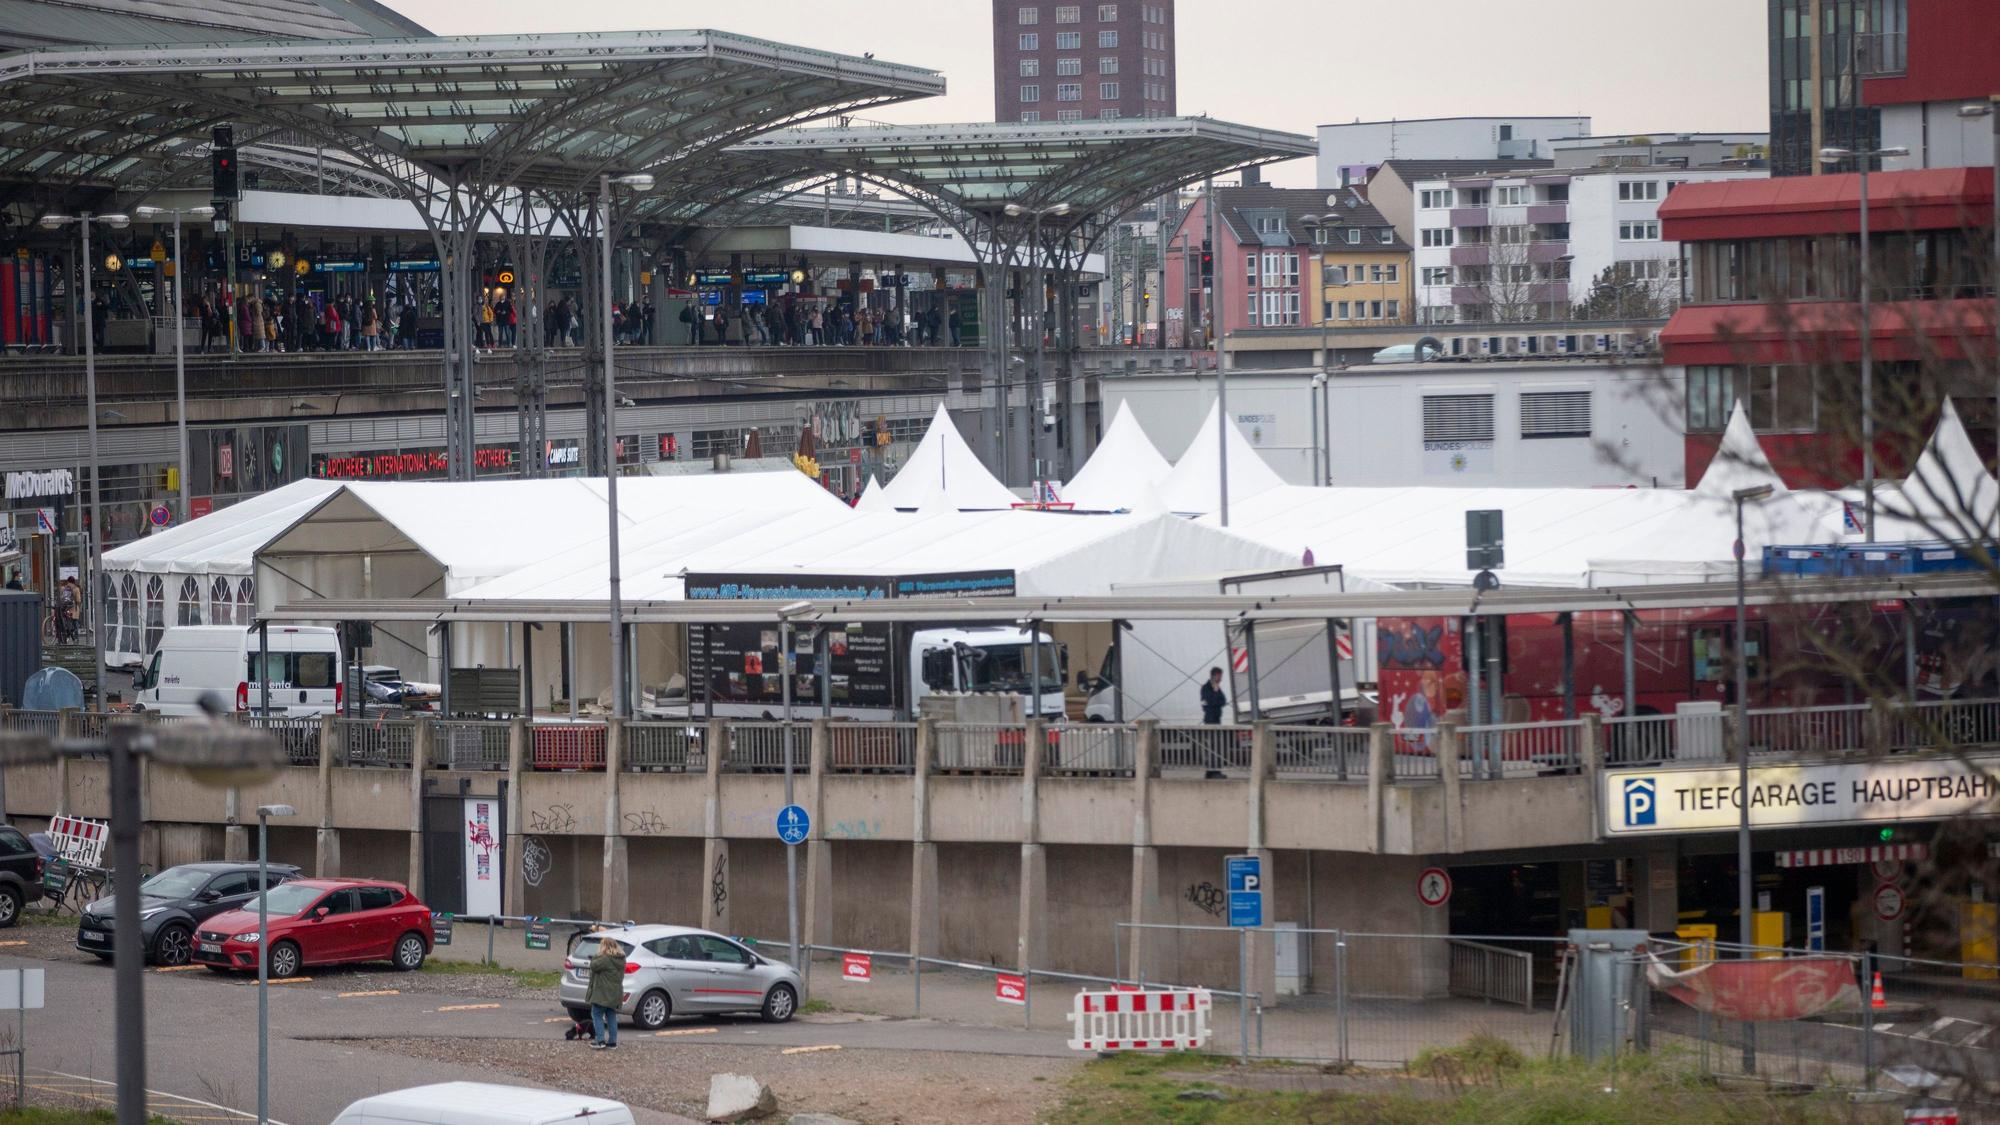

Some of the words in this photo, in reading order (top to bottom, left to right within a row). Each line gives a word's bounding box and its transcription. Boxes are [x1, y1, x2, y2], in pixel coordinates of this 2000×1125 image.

[240, 248, 250, 262] B
[222, 450, 232, 474] DB
[327, 456, 365, 477] APOTHEKE
[373, 453, 428, 475] INTERNATIONAL
[549, 447, 567, 464] CAMPUS
[567, 447, 579, 462] SUITE
[5, 468, 73, 499] McDonald's
[1244, 875, 1258, 892] P
